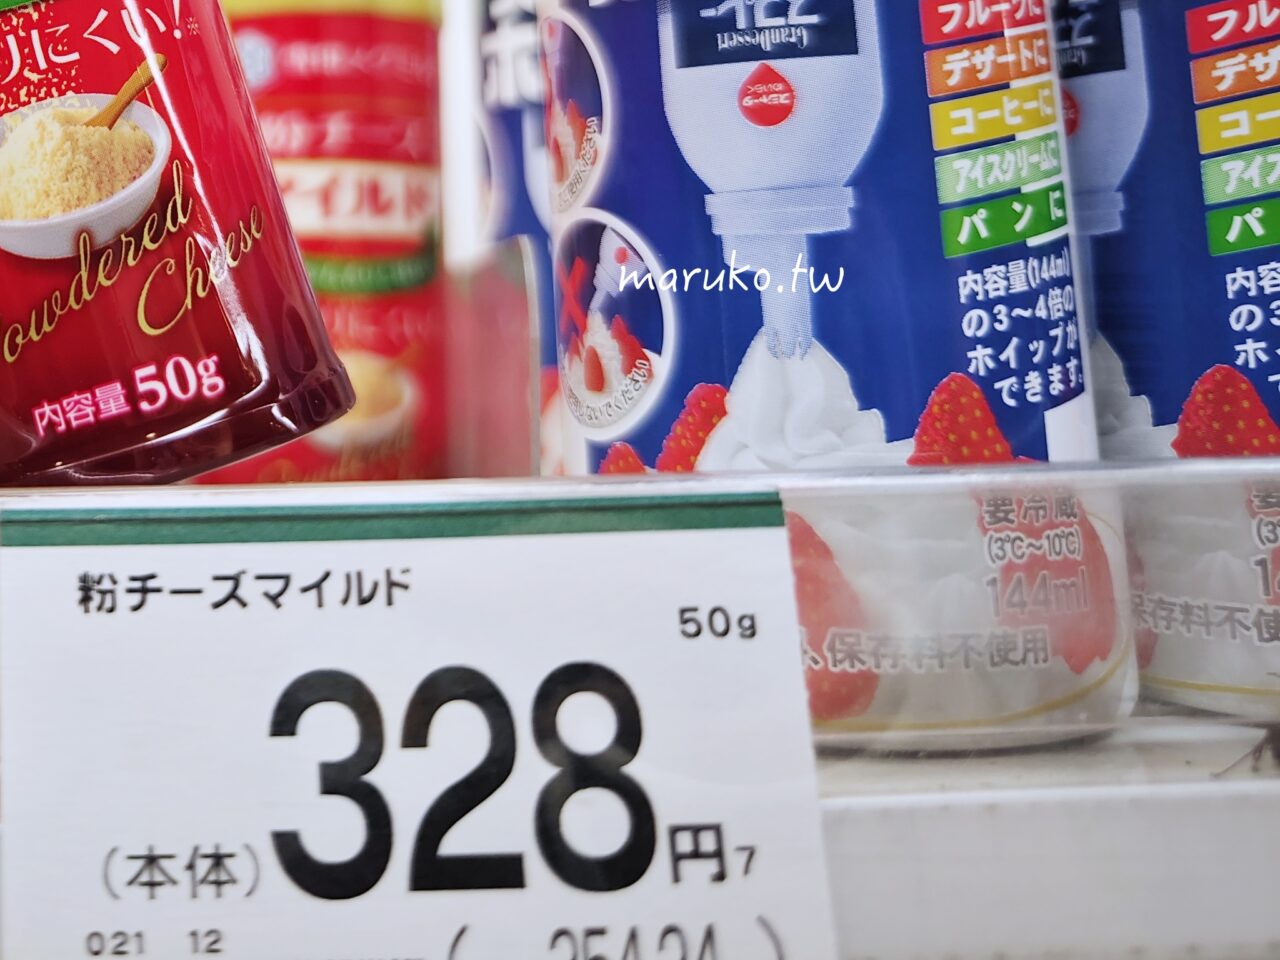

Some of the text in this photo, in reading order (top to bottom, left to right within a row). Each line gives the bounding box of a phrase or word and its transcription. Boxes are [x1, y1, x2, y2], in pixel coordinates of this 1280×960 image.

[942, 38, 1048, 87] デザートに
[949, 88, 1054, 136] コーヒーに
[953, 141, 1058, 194] アイスクリームに
[957, 190, 1065, 245] パンに
[136, 204, 265, 337] Cheese
[958, 246, 1071, 305] 内容量(144ml)
[966, 317, 1078, 377] ホイップが
[33, 354, 225, 438] 内容量 50g
[78, 568, 412, 615] 粉チーズマイルド
[985, 566, 1090, 619] 144ml
[678, 606, 758, 641] 50g
[86, 929, 225, 957] 021 12
